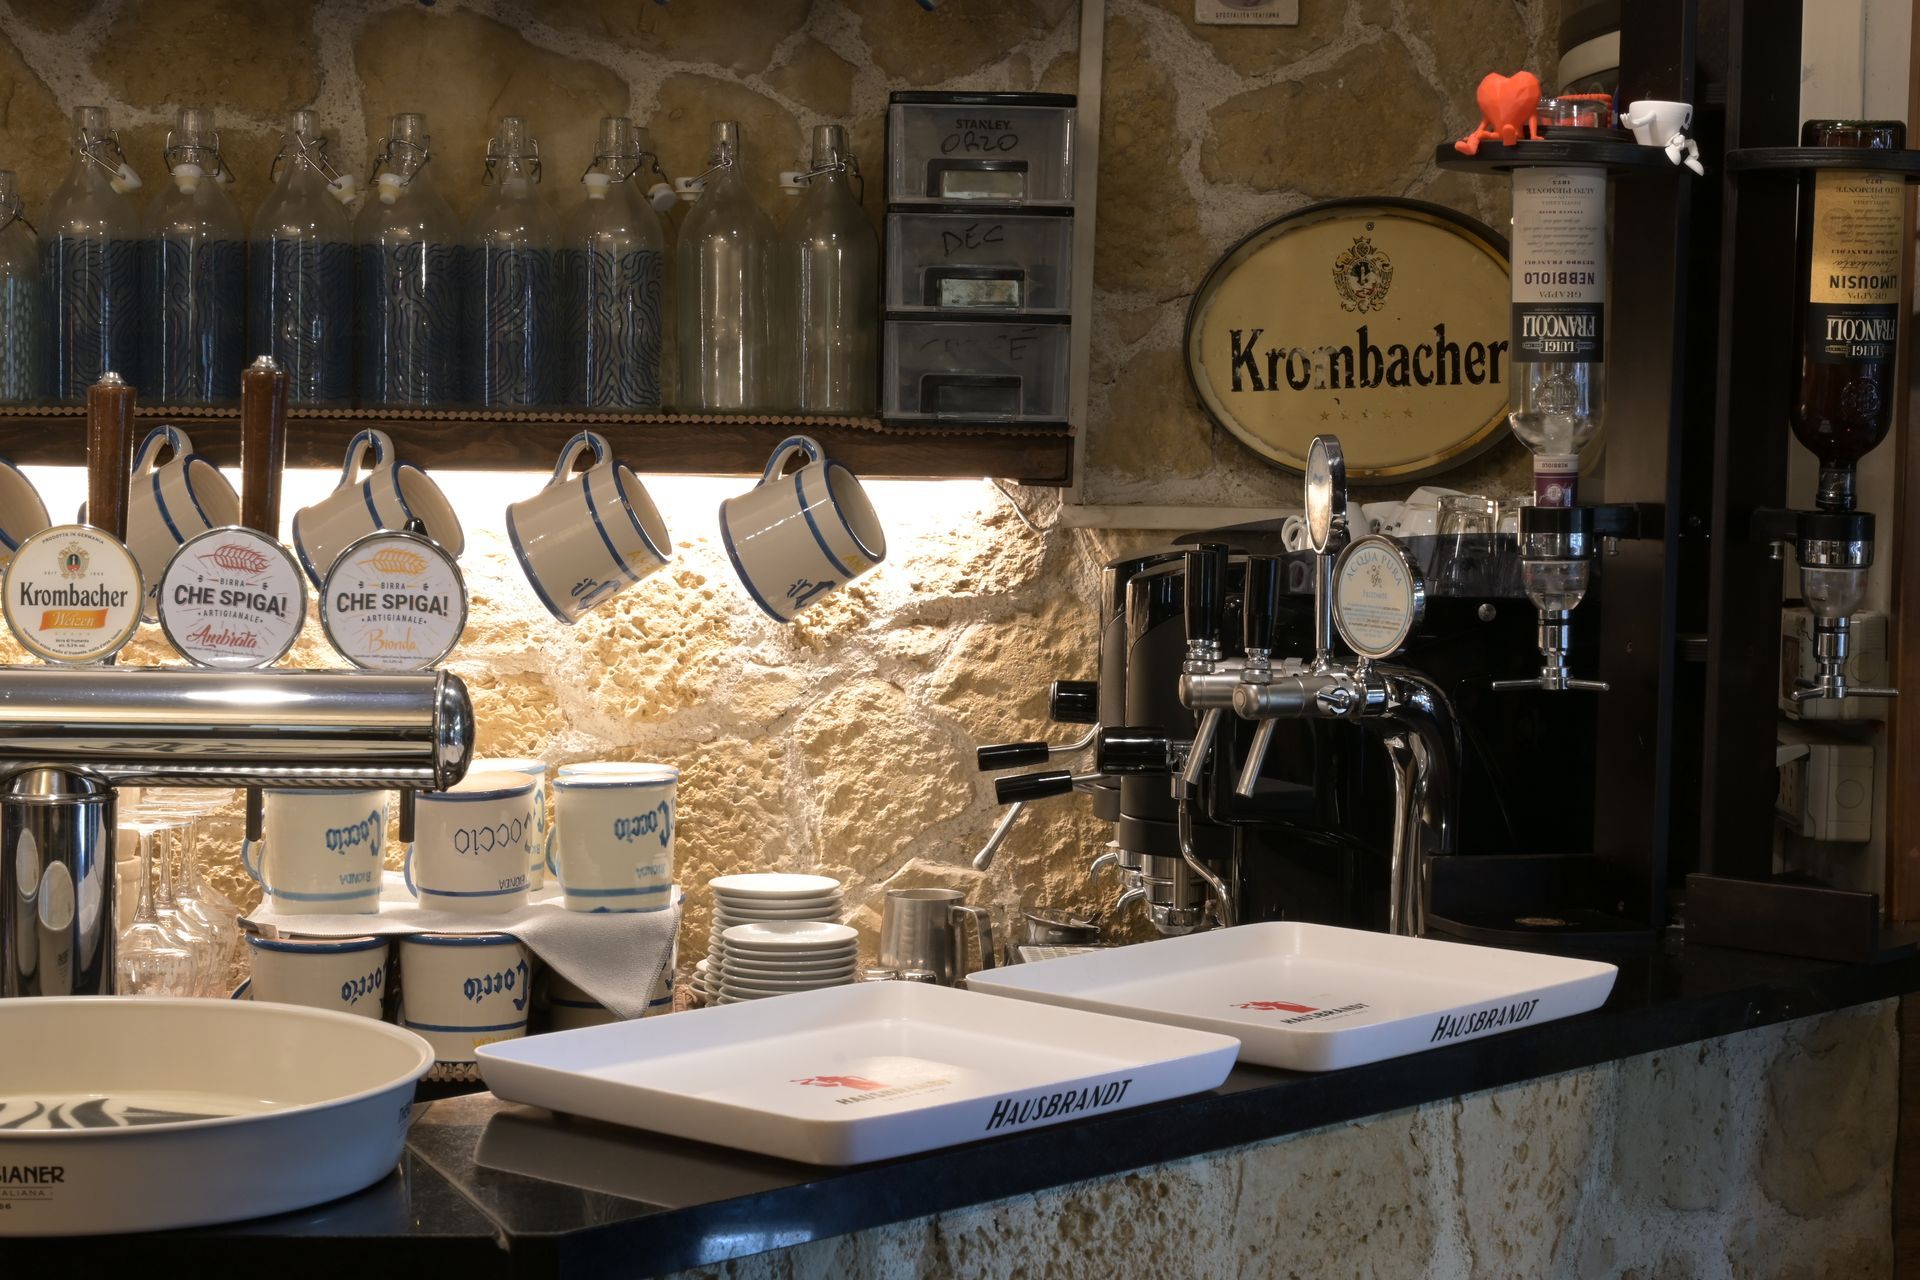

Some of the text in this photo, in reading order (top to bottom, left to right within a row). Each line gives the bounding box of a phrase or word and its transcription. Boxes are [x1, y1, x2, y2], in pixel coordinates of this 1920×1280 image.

[955, 119, 1010, 130] STANLEY
[1524, 272, 1595, 285] NEBBIOLO
[1229, 323, 1509, 392] Krombacher
[1544, 341, 1575, 352] LUIGI
[1852, 345, 1880, 356] LUIGI
[1346, 552, 1402, 587] ACQUA PURA
[20, 581, 128, 608] Krombacher
[219, 577, 245, 588] BIRRA
[380, 581, 406, 590] BIRRA
[174, 584, 215, 605] CHE
[219, 590, 288, 618] SPIGA!
[337, 592, 448, 617] CHE SPIGA!
[52, 611, 95, 627] Weizen
[203, 609, 260, 623] ARTIGIANALE
[366, 615, 423, 625] ARTIGIANALE
[186, 624, 257, 649] Ambrata
[367, 626, 417, 654] Bionda
[325, 810, 381, 857] Coccio
[614, 800, 671, 848] Coccio
[339, 871, 372, 885] BIONDA
[498, 875, 526, 890] BIONDA
[341, 961, 385, 1007] occio
[463, 959, 529, 1011] Coccio
[1430, 999, 1540, 1043] HAUSBRANDT
[985, 1079, 1132, 1131] HAUSBRANDT
[0, 1166, 64, 1184] IANER
